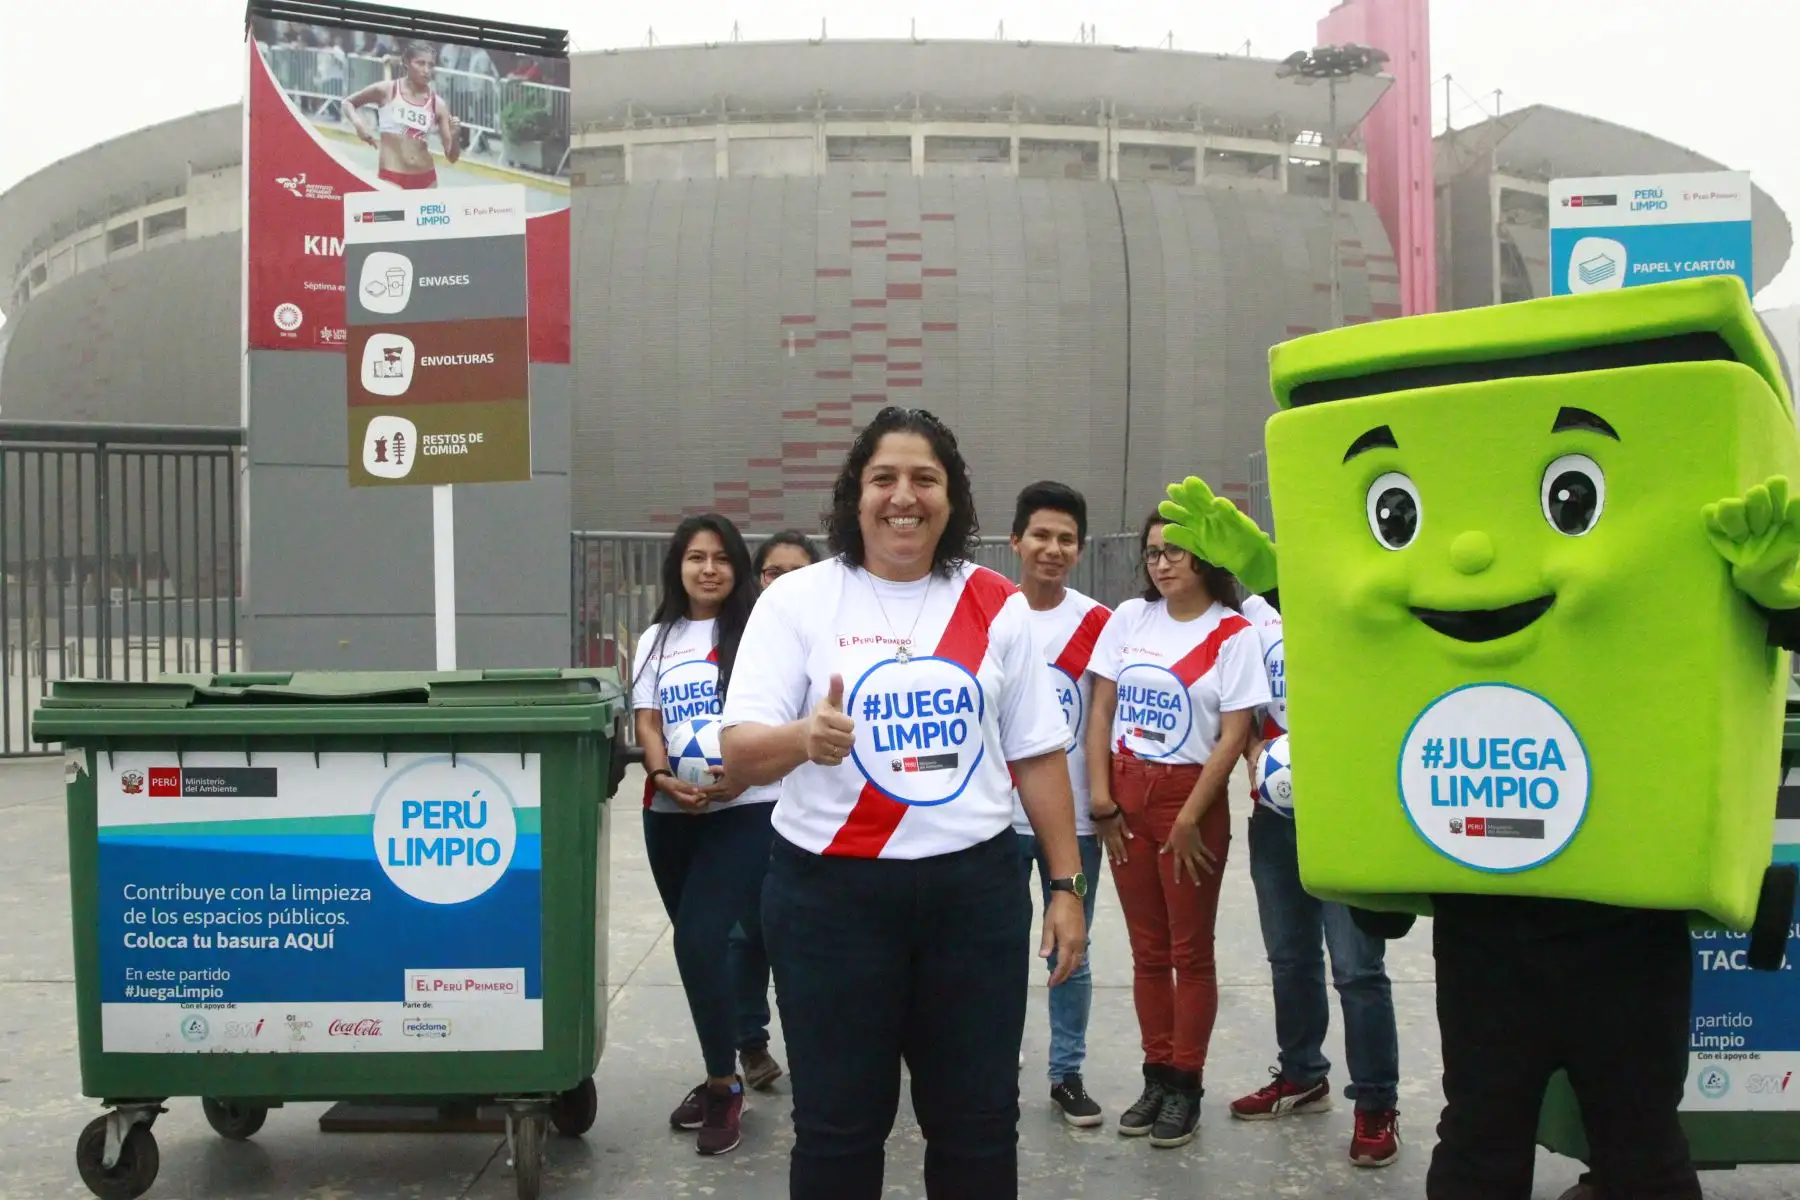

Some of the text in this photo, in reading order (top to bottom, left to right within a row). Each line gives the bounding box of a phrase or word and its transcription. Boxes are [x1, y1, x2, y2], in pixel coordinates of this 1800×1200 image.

[397, 107, 426, 126] 138
[1630, 200, 1668, 211] LIMPIO
[416, 215, 450, 226] LIMPIO
[1633, 258, 1735, 273] PAPEL Y CARTÓN
[304, 281, 337, 291] Séptima
[419, 274, 470, 287] ENVASES
[421, 353, 494, 367] ENVOLTURAS
[423, 432, 484, 445] RESTOS DE
[423, 444, 468, 456] COMIDA
[863, 686, 974, 721] #JUEGA
[1118, 684, 1182, 712] #JUEGA
[664, 699, 723, 724] LIMPIO
[1119, 704, 1176, 730] LIMPIO
[872, 718, 967, 752] LIMPIO
[1421, 737, 1567, 771] #JUEGA
[152, 777, 225, 786] PERÚ Ministerio
[199, 785, 238, 793] Ambiente
[1430, 775, 1559, 810] LIMPIO
[402, 790, 487, 829] PERÚ
[388, 837, 501, 866] LIMPIO
[123, 883, 371, 904] Contribuye con la limpieza
[123, 907, 349, 928] de los espacios públicos.
[123, 928, 334, 951] Coloca tu basura AQUÍ
[125, 967, 231, 983] En este partido
[125, 984, 224, 1001] #JuegaLimpio
[416, 979, 430, 991] EL
[465, 979, 514, 991] PRIMERO
[1695, 1012, 1753, 1031] partido
[1749, 1052, 1760, 1060] de:
